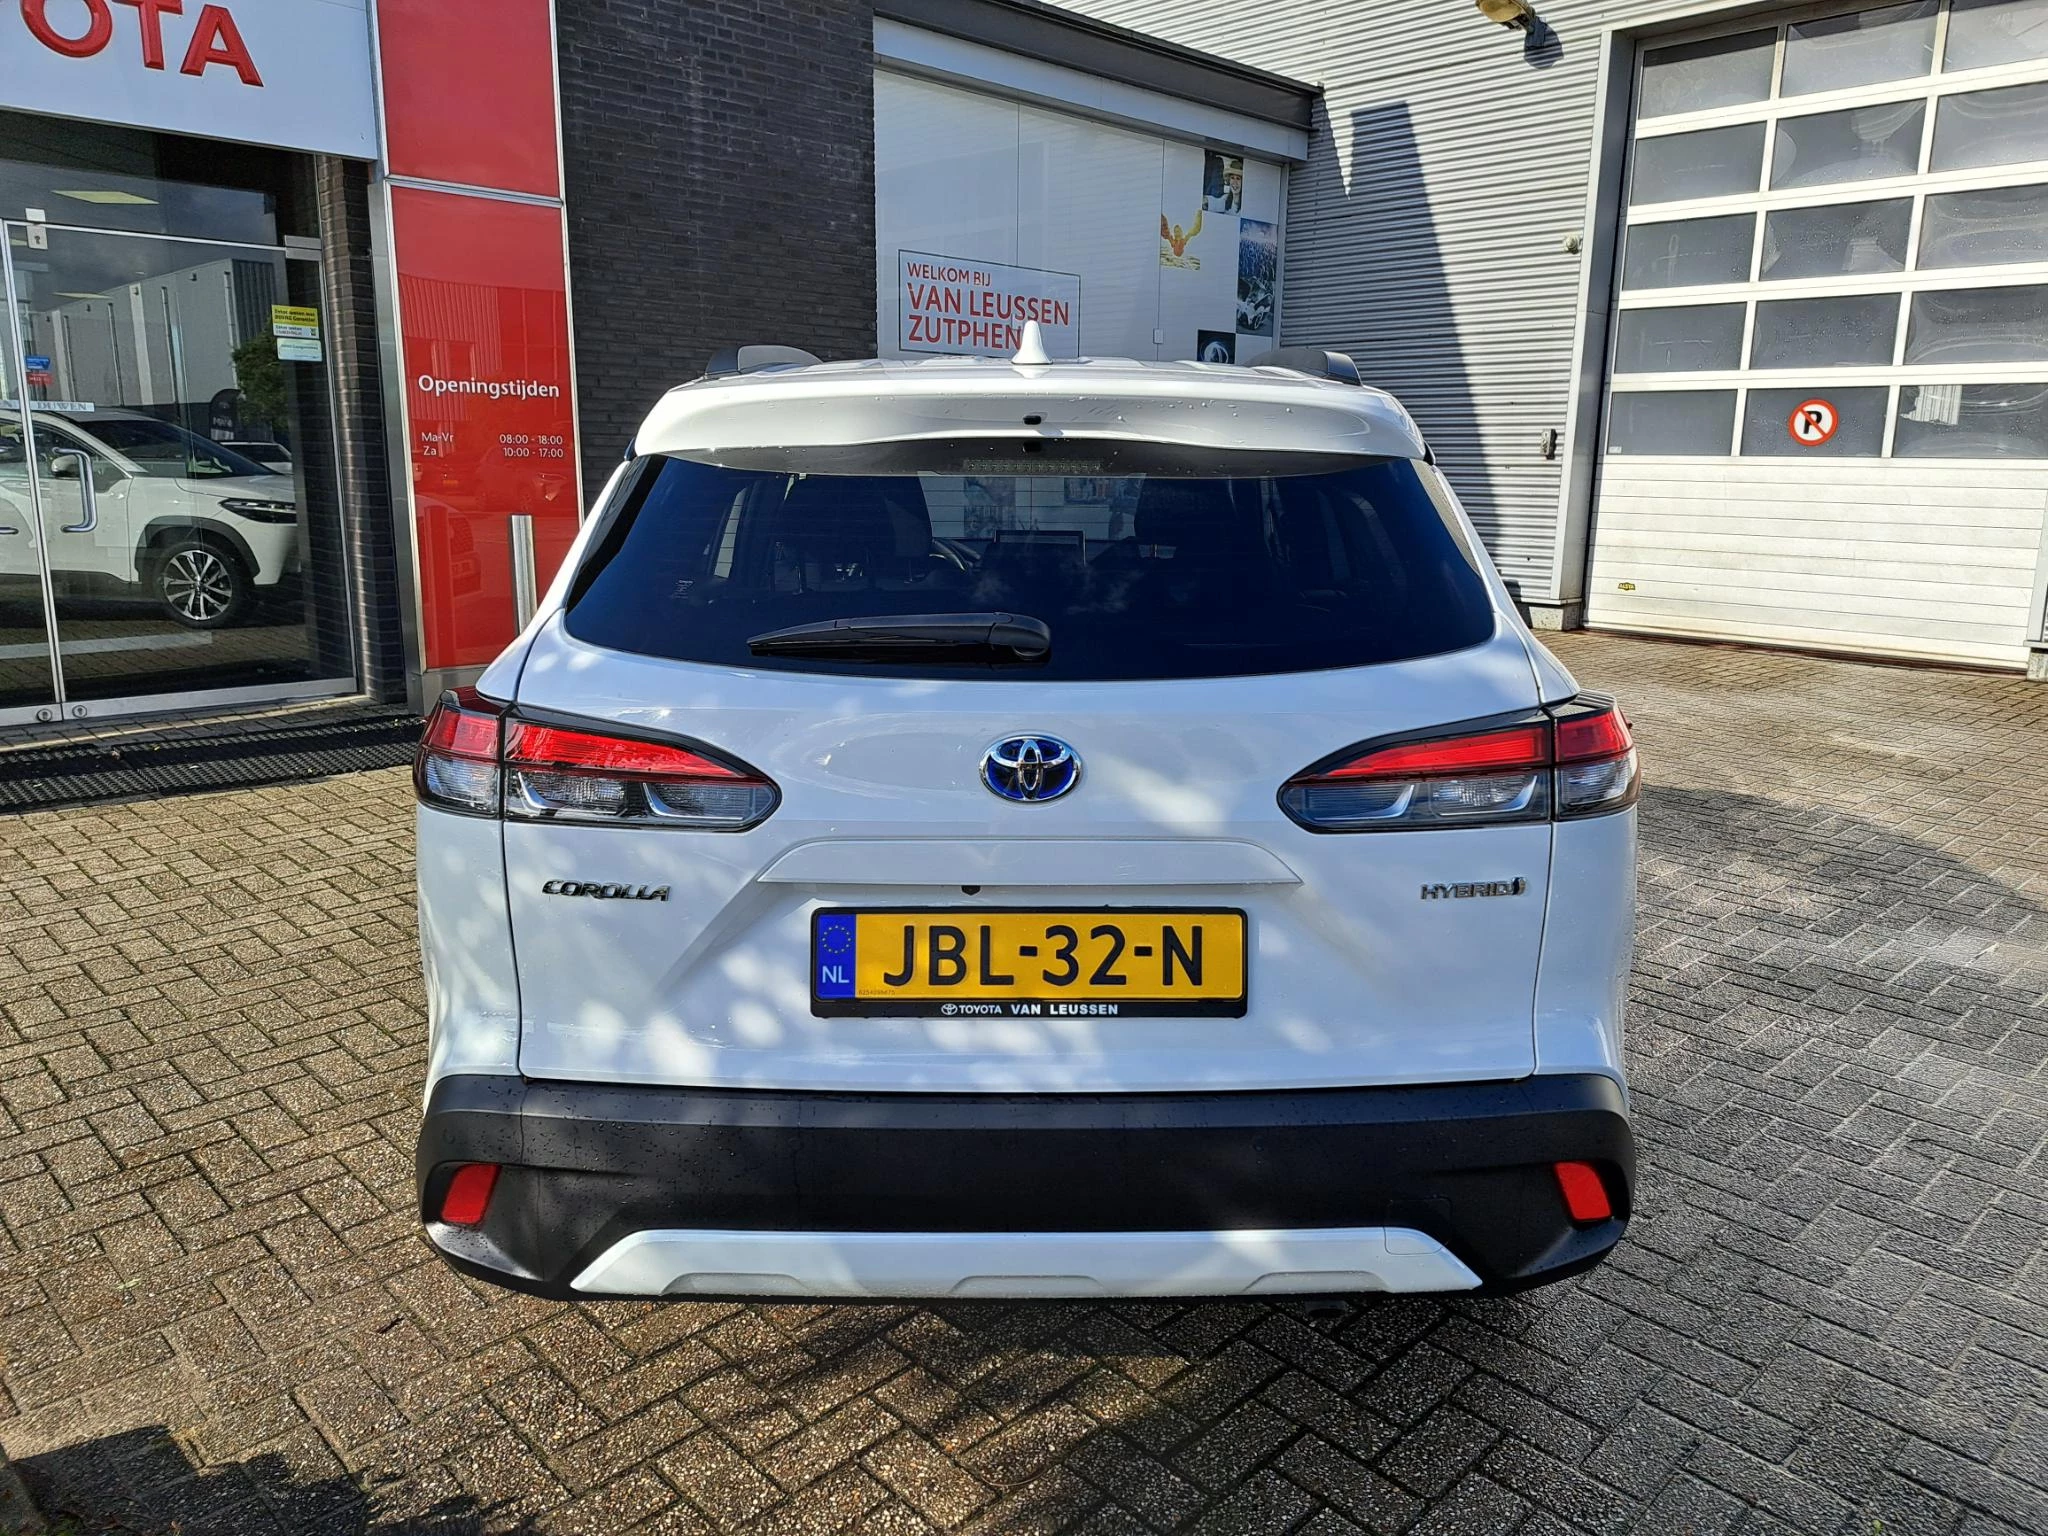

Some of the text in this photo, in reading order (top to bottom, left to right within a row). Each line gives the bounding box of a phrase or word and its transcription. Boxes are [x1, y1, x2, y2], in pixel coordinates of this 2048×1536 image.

[906, 262, 991, 287] WELKOM BIJ
[906, 281, 1070, 326] VAN LEUSSEN
[907, 314, 1022, 350] ZUTPHEN
[418, 374, 560, 401] Openingstijden
[499, 433, 529, 445] 08:00
[538, 434, 563, 445] 18:00
[423, 445, 437, 456] Za
[503, 447, 530, 458] 10:00
[539, 447, 564, 458] 17:00
[541, 879, 672, 901] COROLLA
[1420, 880, 1515, 900] HYBRID
[822, 925, 1204, 987] NL JBL-32-N
[959, 1004, 1118, 1015] TOYOTA VAN LEUSSEN
